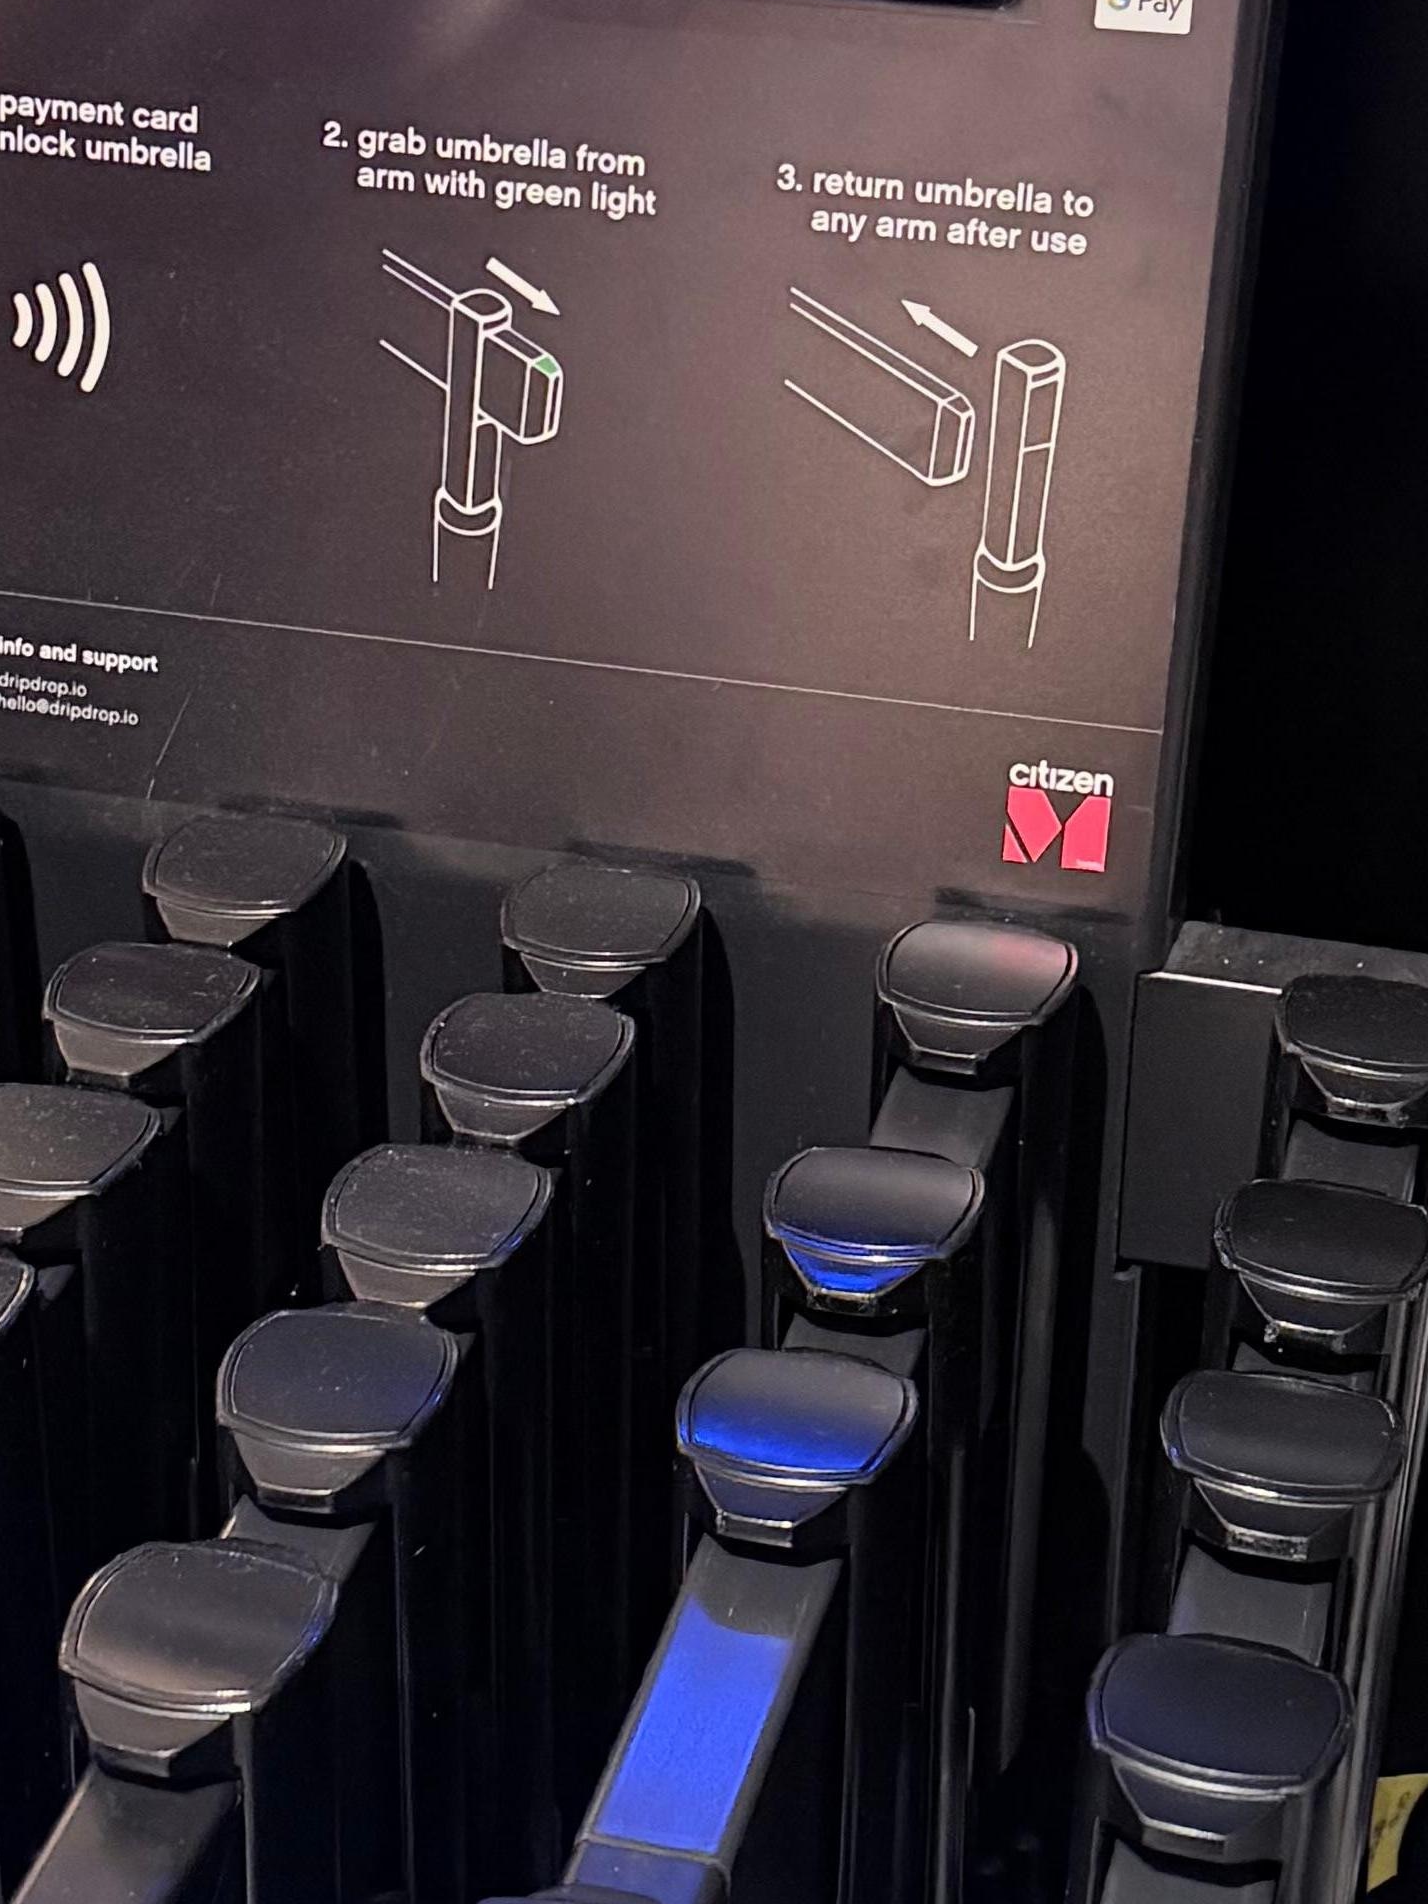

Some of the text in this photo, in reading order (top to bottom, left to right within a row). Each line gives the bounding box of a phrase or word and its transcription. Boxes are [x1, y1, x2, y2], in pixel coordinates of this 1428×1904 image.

[0, 94, 125, 126] payment
[132, 105, 198, 134] card
[85, 136, 211, 172] umbrella
[323, 120, 645, 177] 2. grab umbrella from
[357, 166, 657, 221] arm with green light
[777, 163, 1094, 218] 3. return umbrella to
[810, 210, 1088, 256] any arm after use
[39, 643, 77, 663] and
[82, 650, 159, 674] support
[1009, 759, 1115, 797] citizen
